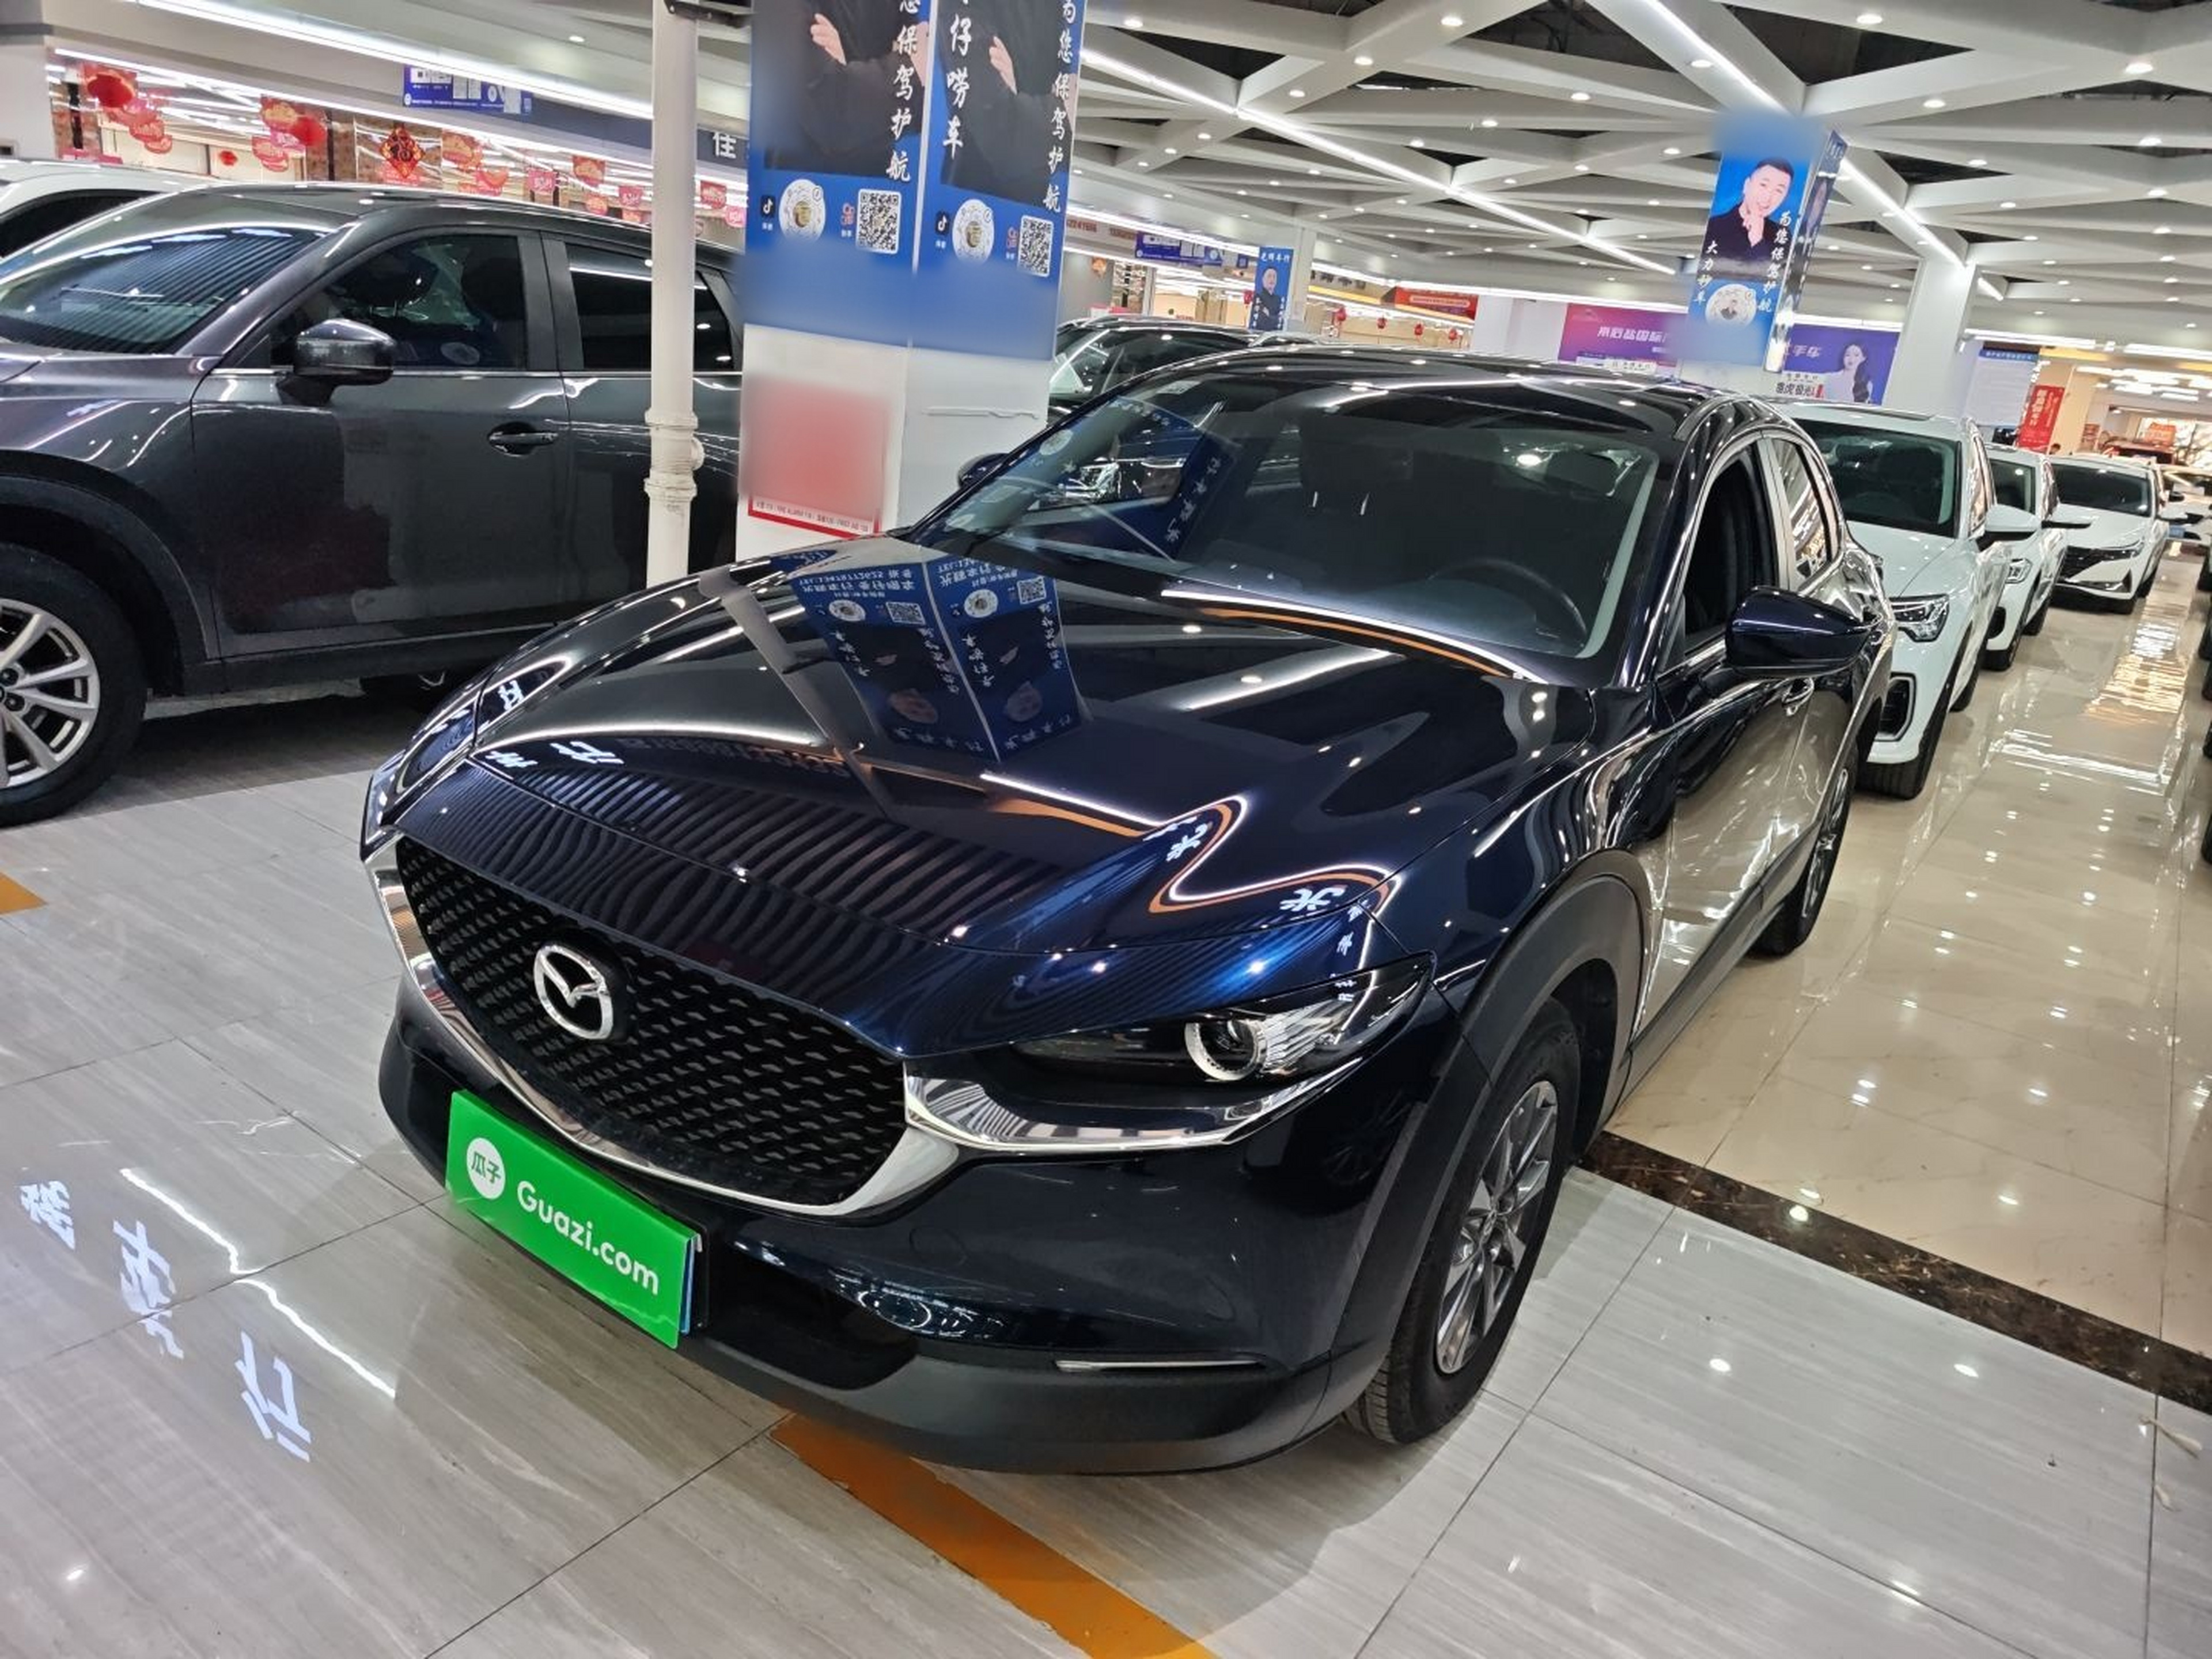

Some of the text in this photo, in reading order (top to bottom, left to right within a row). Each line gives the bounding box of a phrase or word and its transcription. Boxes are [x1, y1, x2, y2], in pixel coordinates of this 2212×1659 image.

[942, 0, 972, 160] 仔唠车
[471, 1151, 502, 1184] 瓜子
[517, 1181, 659, 1296] Guazi.com
